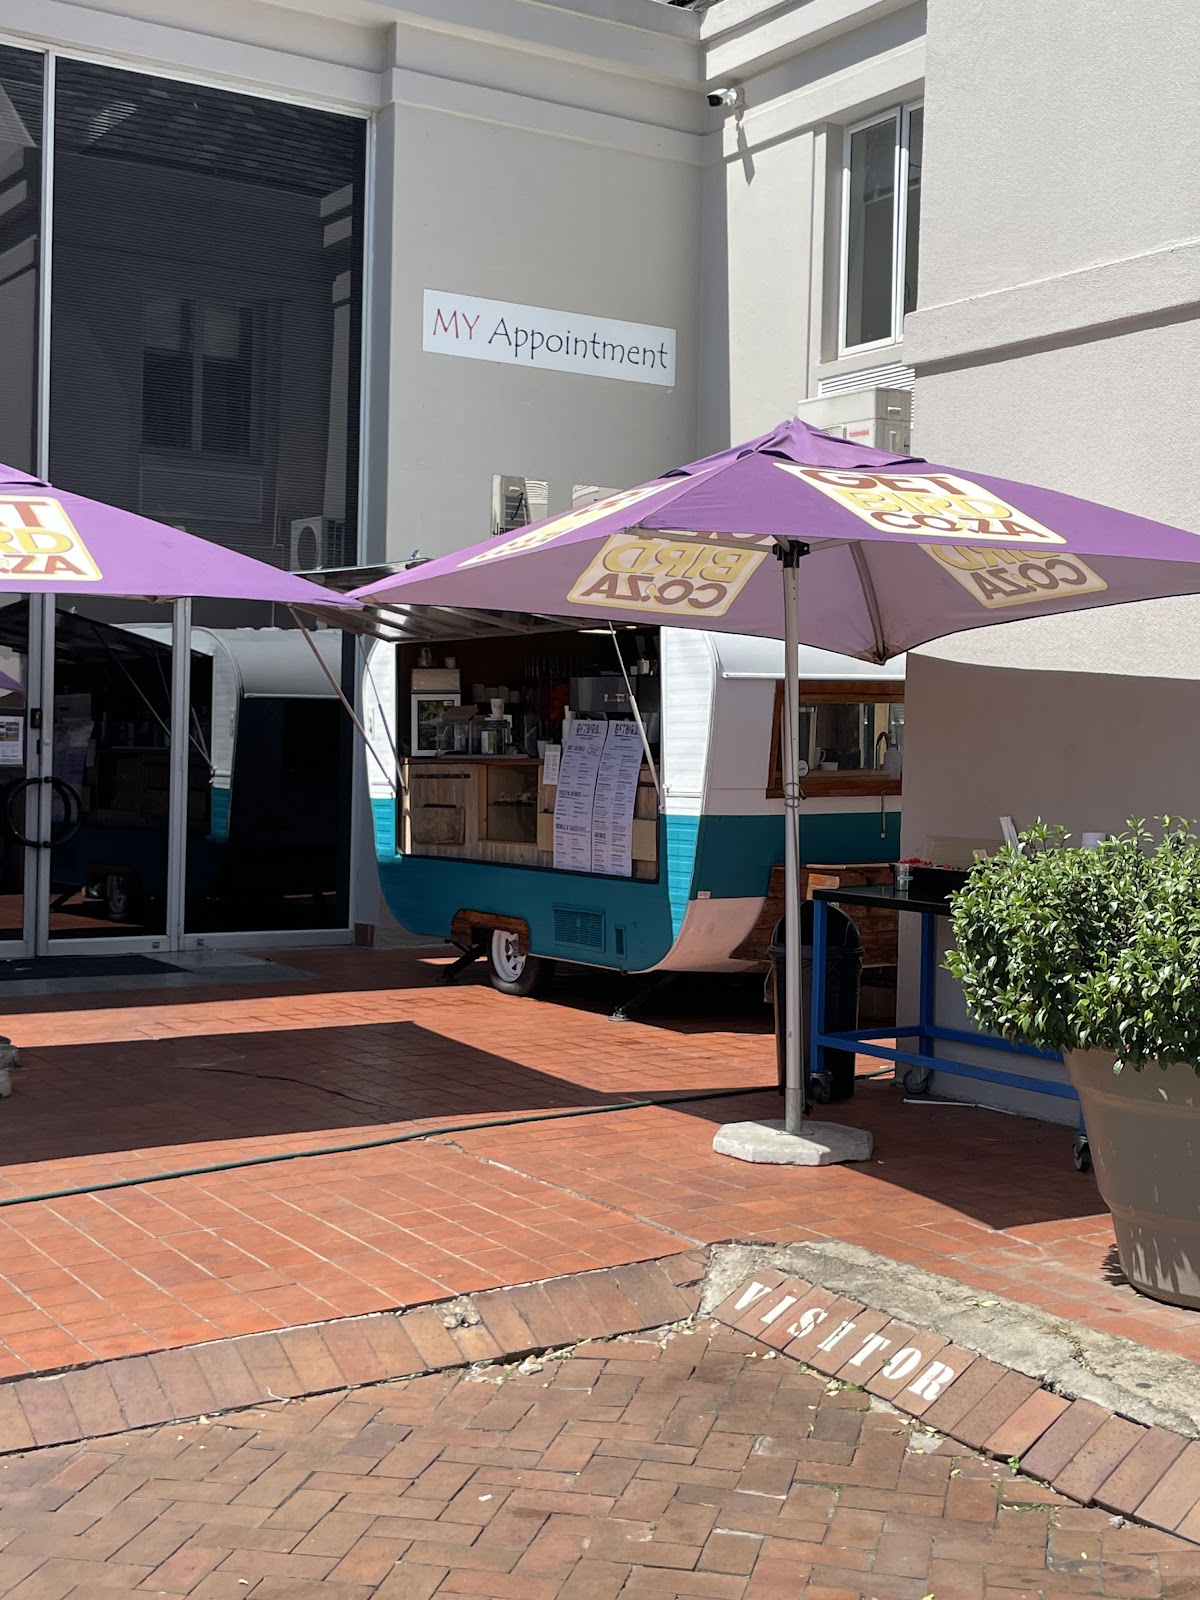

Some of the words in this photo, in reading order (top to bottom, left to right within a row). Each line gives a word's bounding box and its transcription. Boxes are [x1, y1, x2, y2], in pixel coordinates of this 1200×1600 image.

[432, 308, 481, 341] MY
[487, 317, 668, 369] Appointment
[848, 429, 870, 438] TOSHIBA
[799, 469, 967, 496] GET
[832, 488, 1013, 519] BIRD
[733, 1281, 955, 1401] VISITOR
